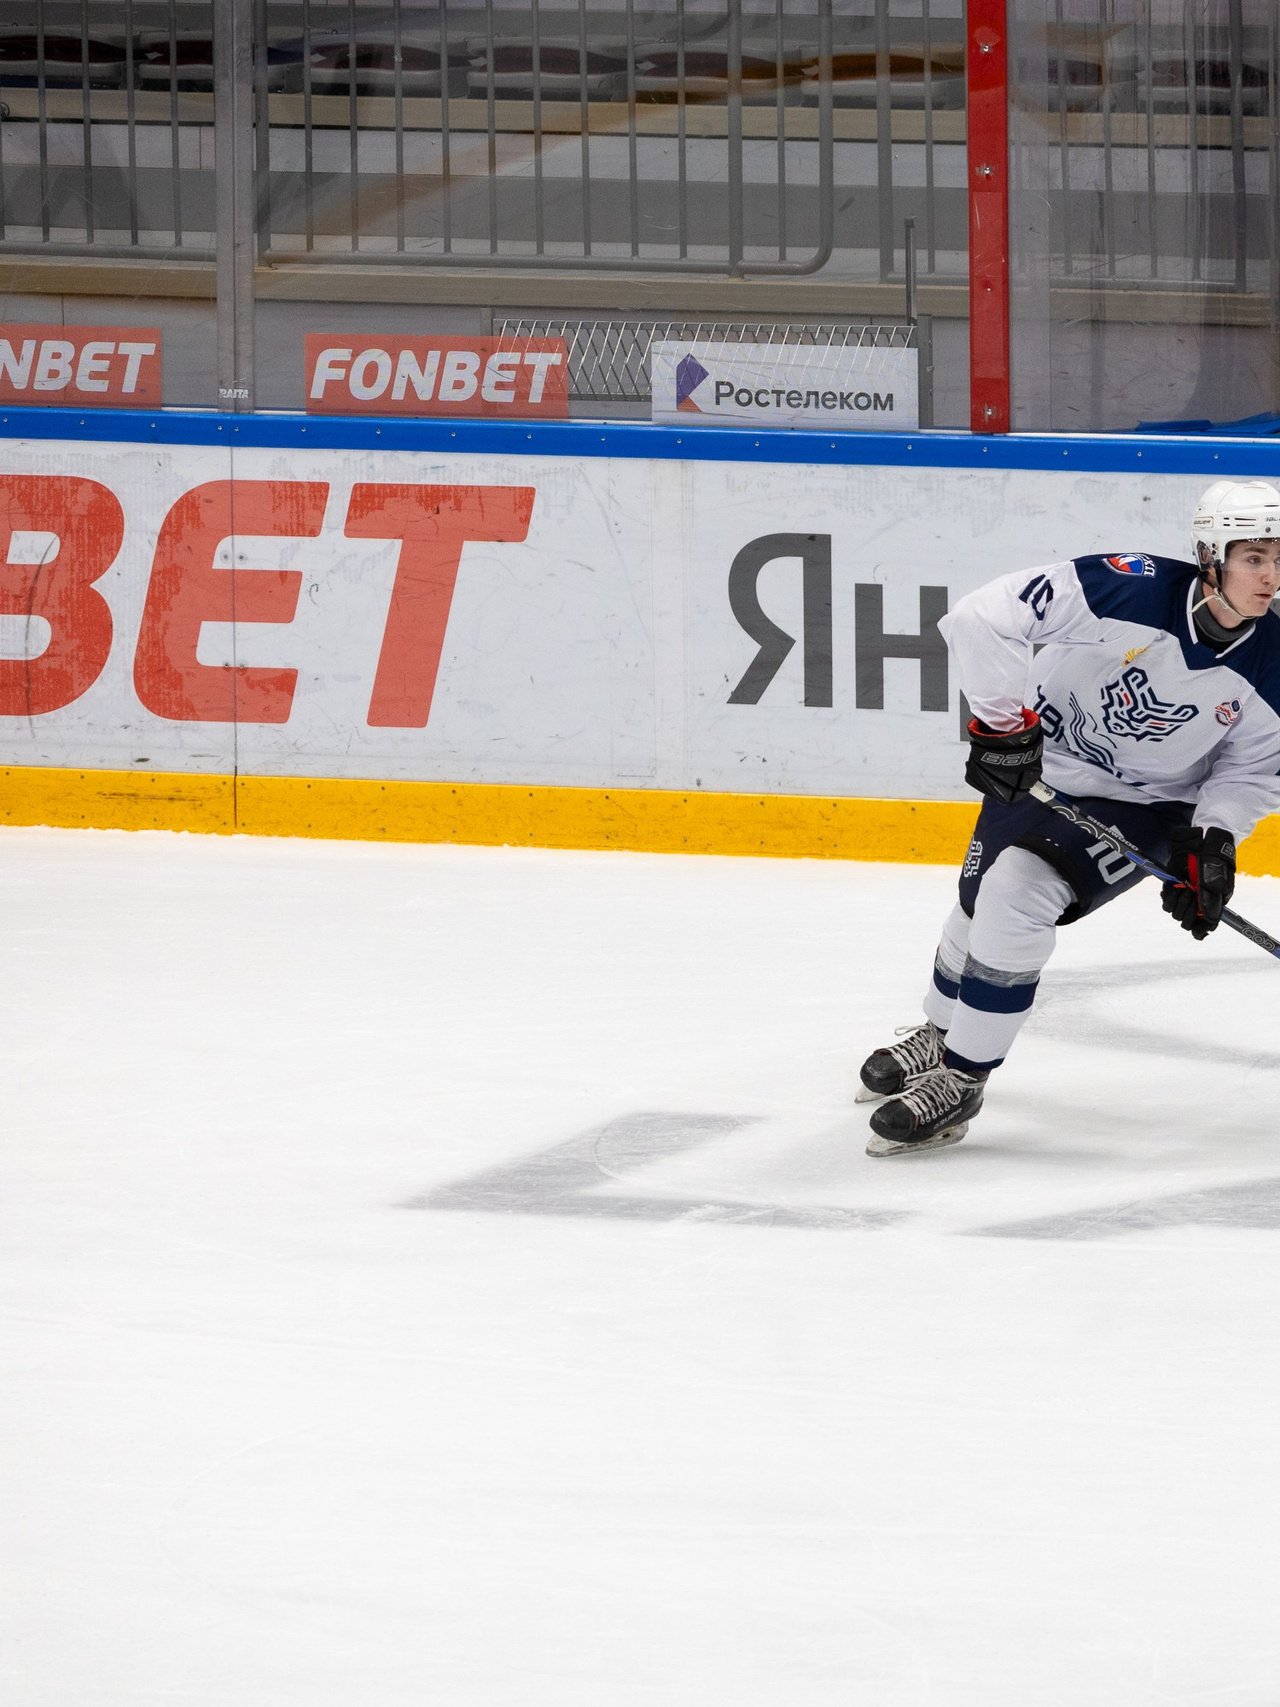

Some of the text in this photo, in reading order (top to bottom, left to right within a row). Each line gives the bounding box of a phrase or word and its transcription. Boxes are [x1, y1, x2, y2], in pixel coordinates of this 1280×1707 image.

[0, 339, 157, 393] NBET
[310, 348, 564, 404] FONBET
[714, 381, 895, 412] Ростелеком
[0, 474, 536, 729] BET
[980, 745, 1042, 767] BAU
[1086, 814, 1139, 851] SHERWOOD
